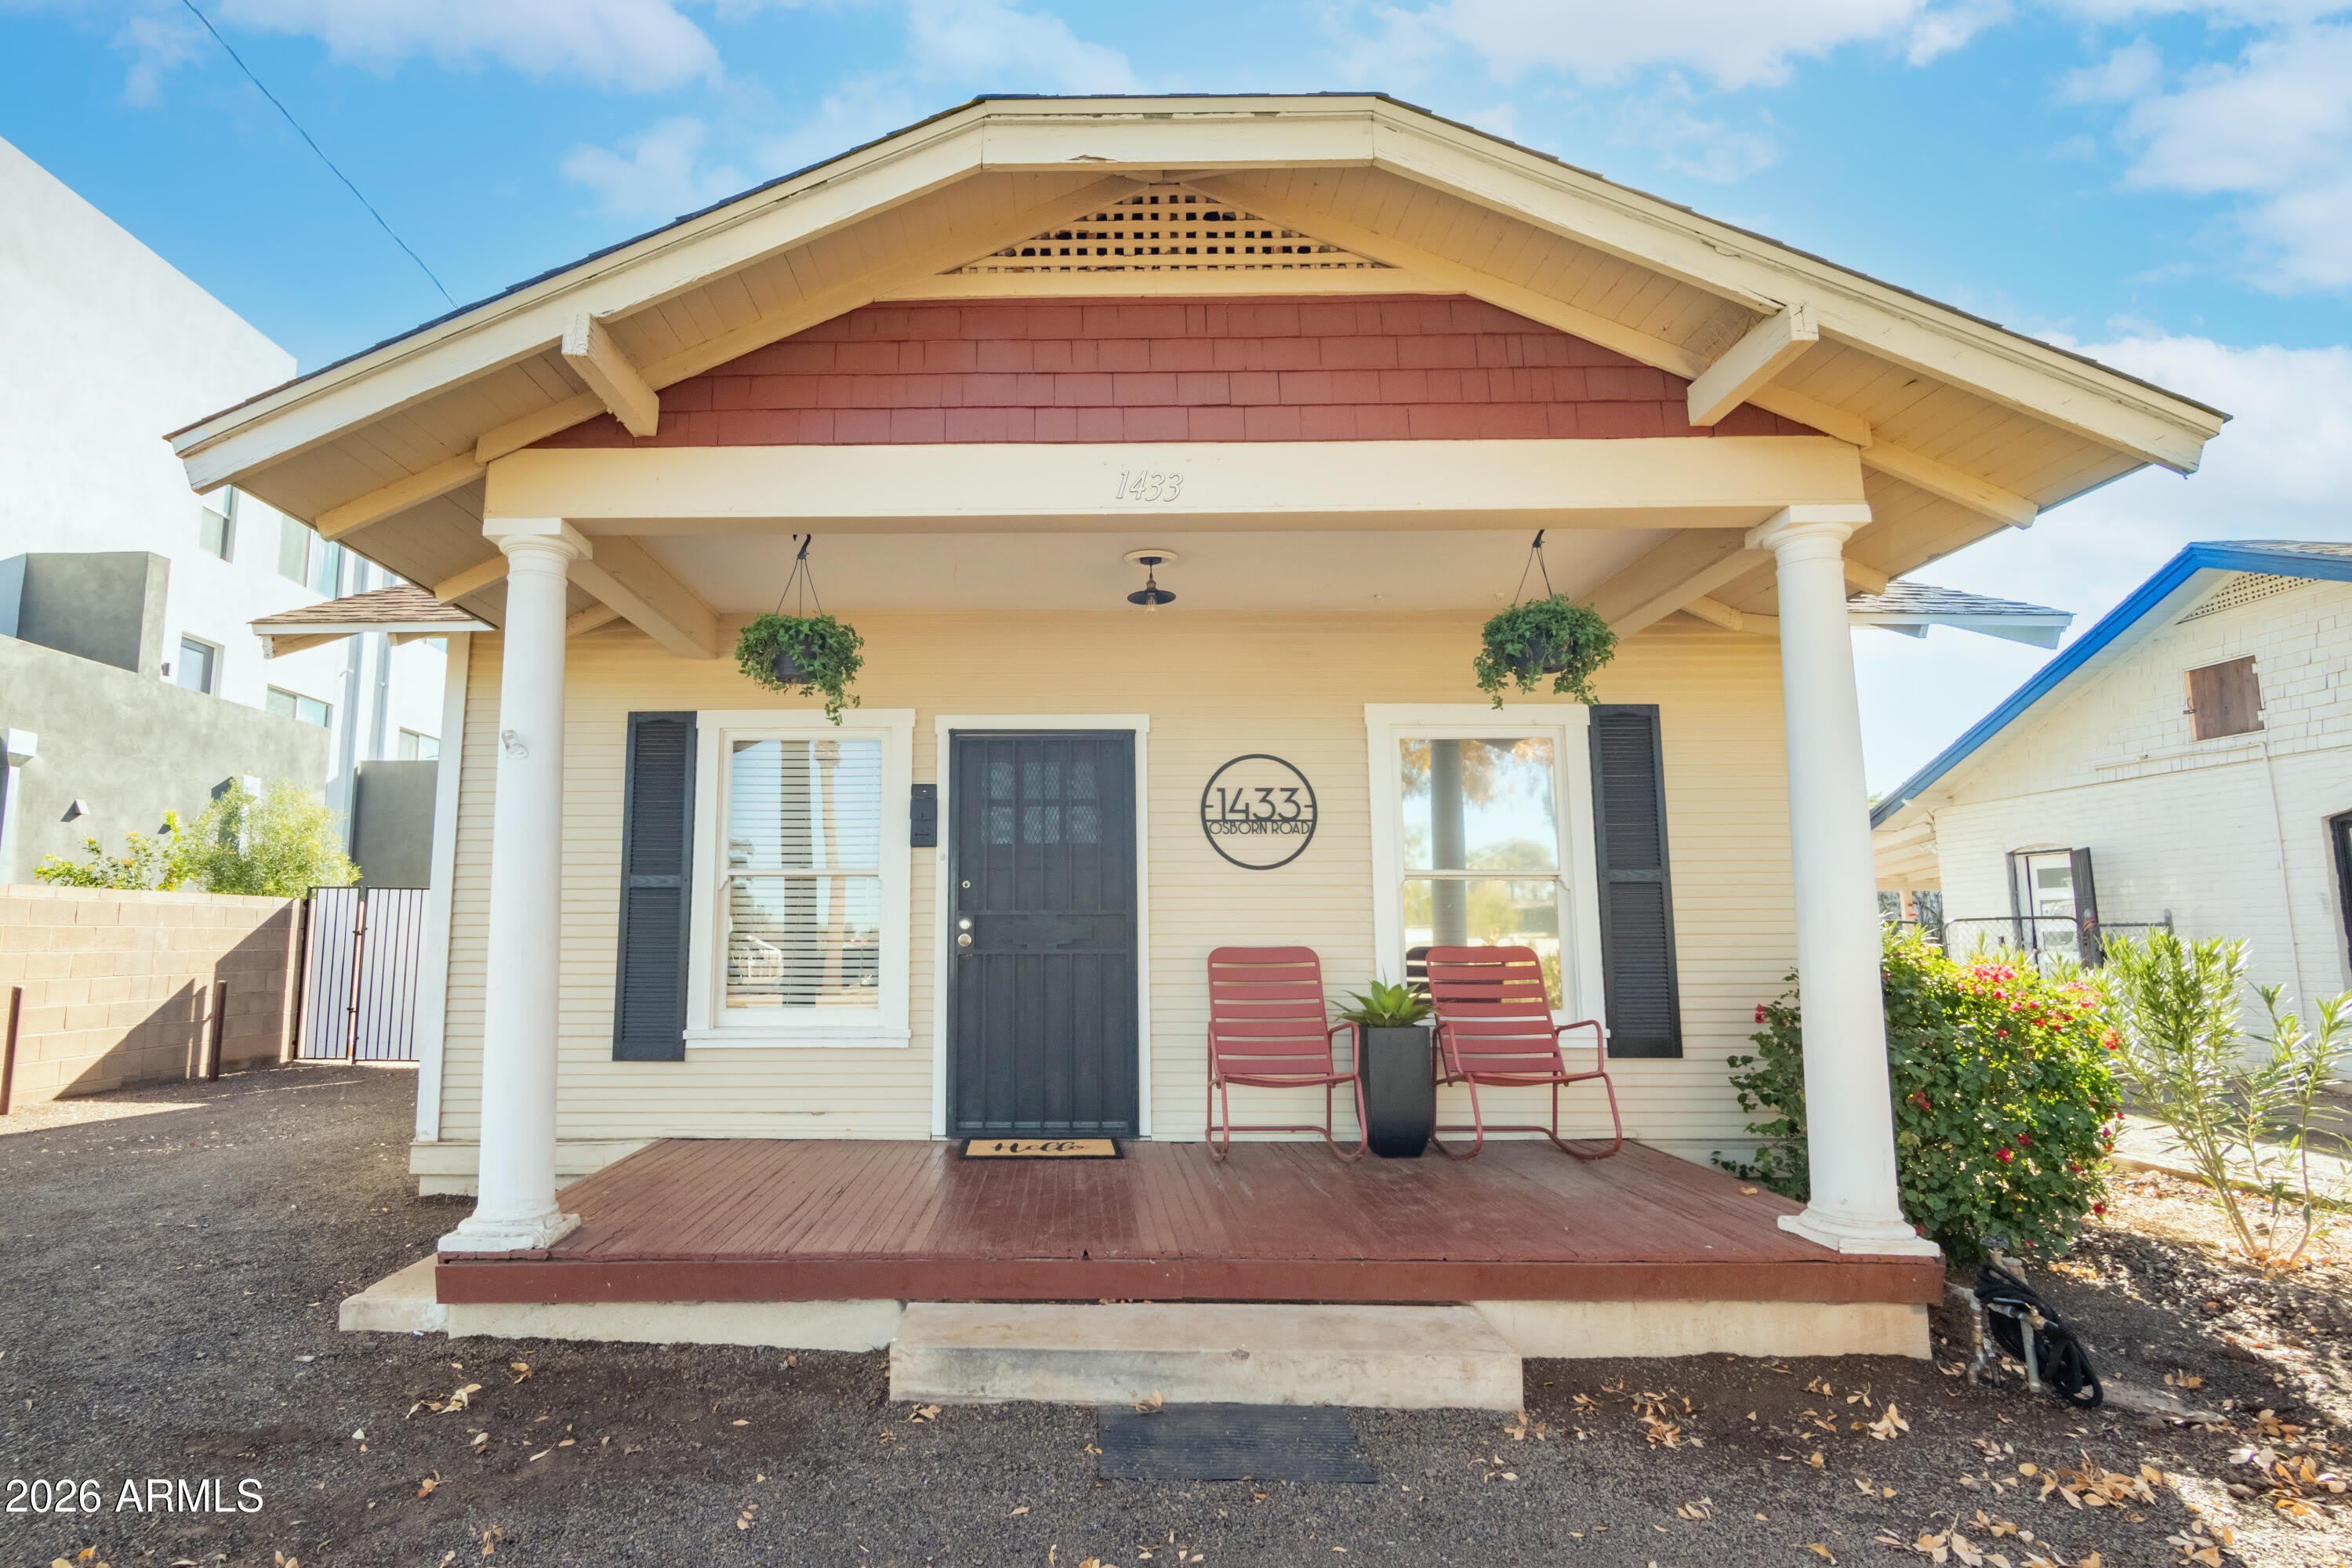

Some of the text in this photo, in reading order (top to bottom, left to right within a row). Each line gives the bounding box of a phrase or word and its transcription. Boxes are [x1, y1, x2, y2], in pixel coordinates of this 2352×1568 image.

[1116, 470, 1184, 503] 1433
[1216, 787, 1301, 822] 1433
[1209, 821, 1310, 835] OSBORN ROAD
[992, 1142, 1091, 1153] Hello
